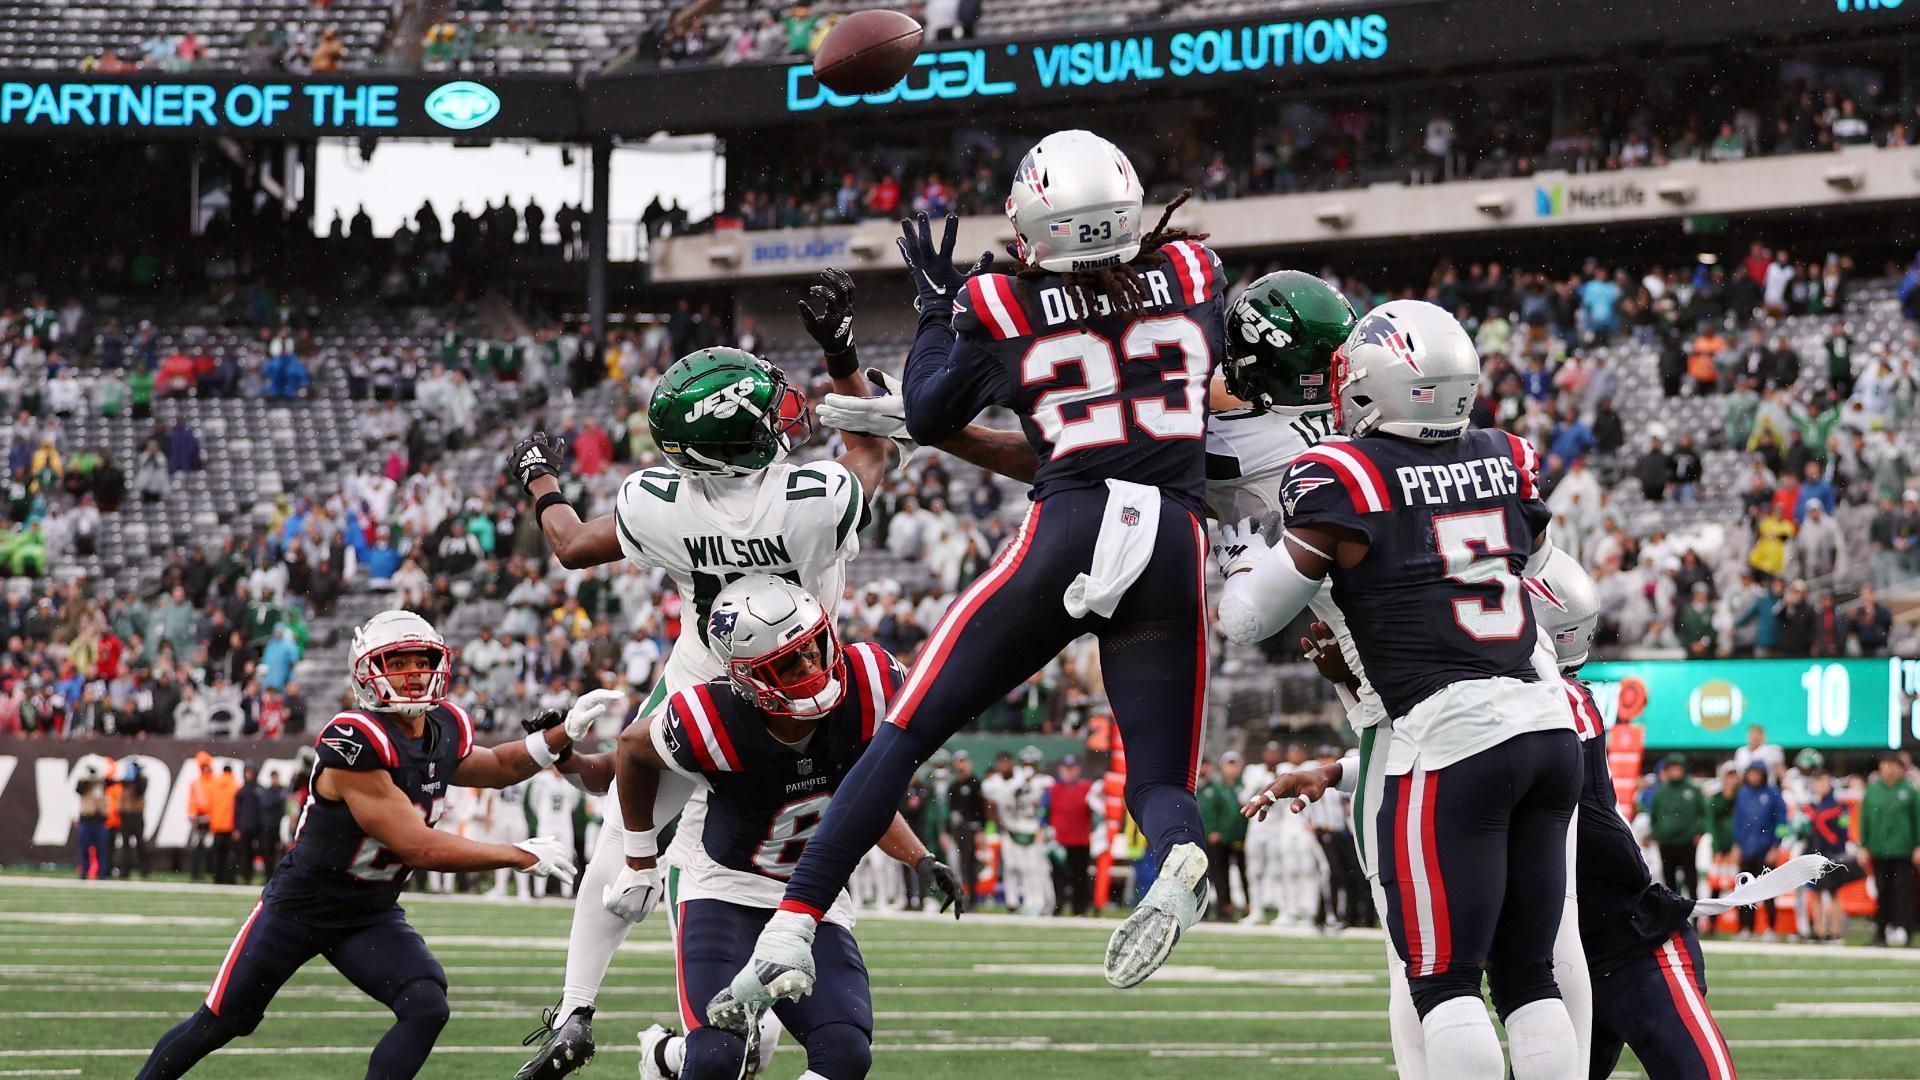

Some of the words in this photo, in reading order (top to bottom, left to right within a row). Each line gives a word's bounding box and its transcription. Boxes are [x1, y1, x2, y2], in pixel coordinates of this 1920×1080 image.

[1033, 37, 1164, 88] VISUAL
[1169, 14, 1388, 77] SOLUTIONS
[0, 83, 217, 126] PARTNER
[225, 84, 292, 126] OF
[304, 85, 399, 127] THE
[1072, 254, 1120, 271] PATRIOTS
[1235, 301, 1293, 348] JETS
[684, 377, 755, 423] JETS
[1020, 313, 1212, 461] 23
[1455, 397, 1467, 416] 5
[1396, 456, 1517, 506] PEPPERS
[683, 535, 792, 568] WILSON
[1431, 507, 1526, 641] 5
[1801, 663, 1850, 737] 10
[785, 776, 827, 794] PATRIOTS
